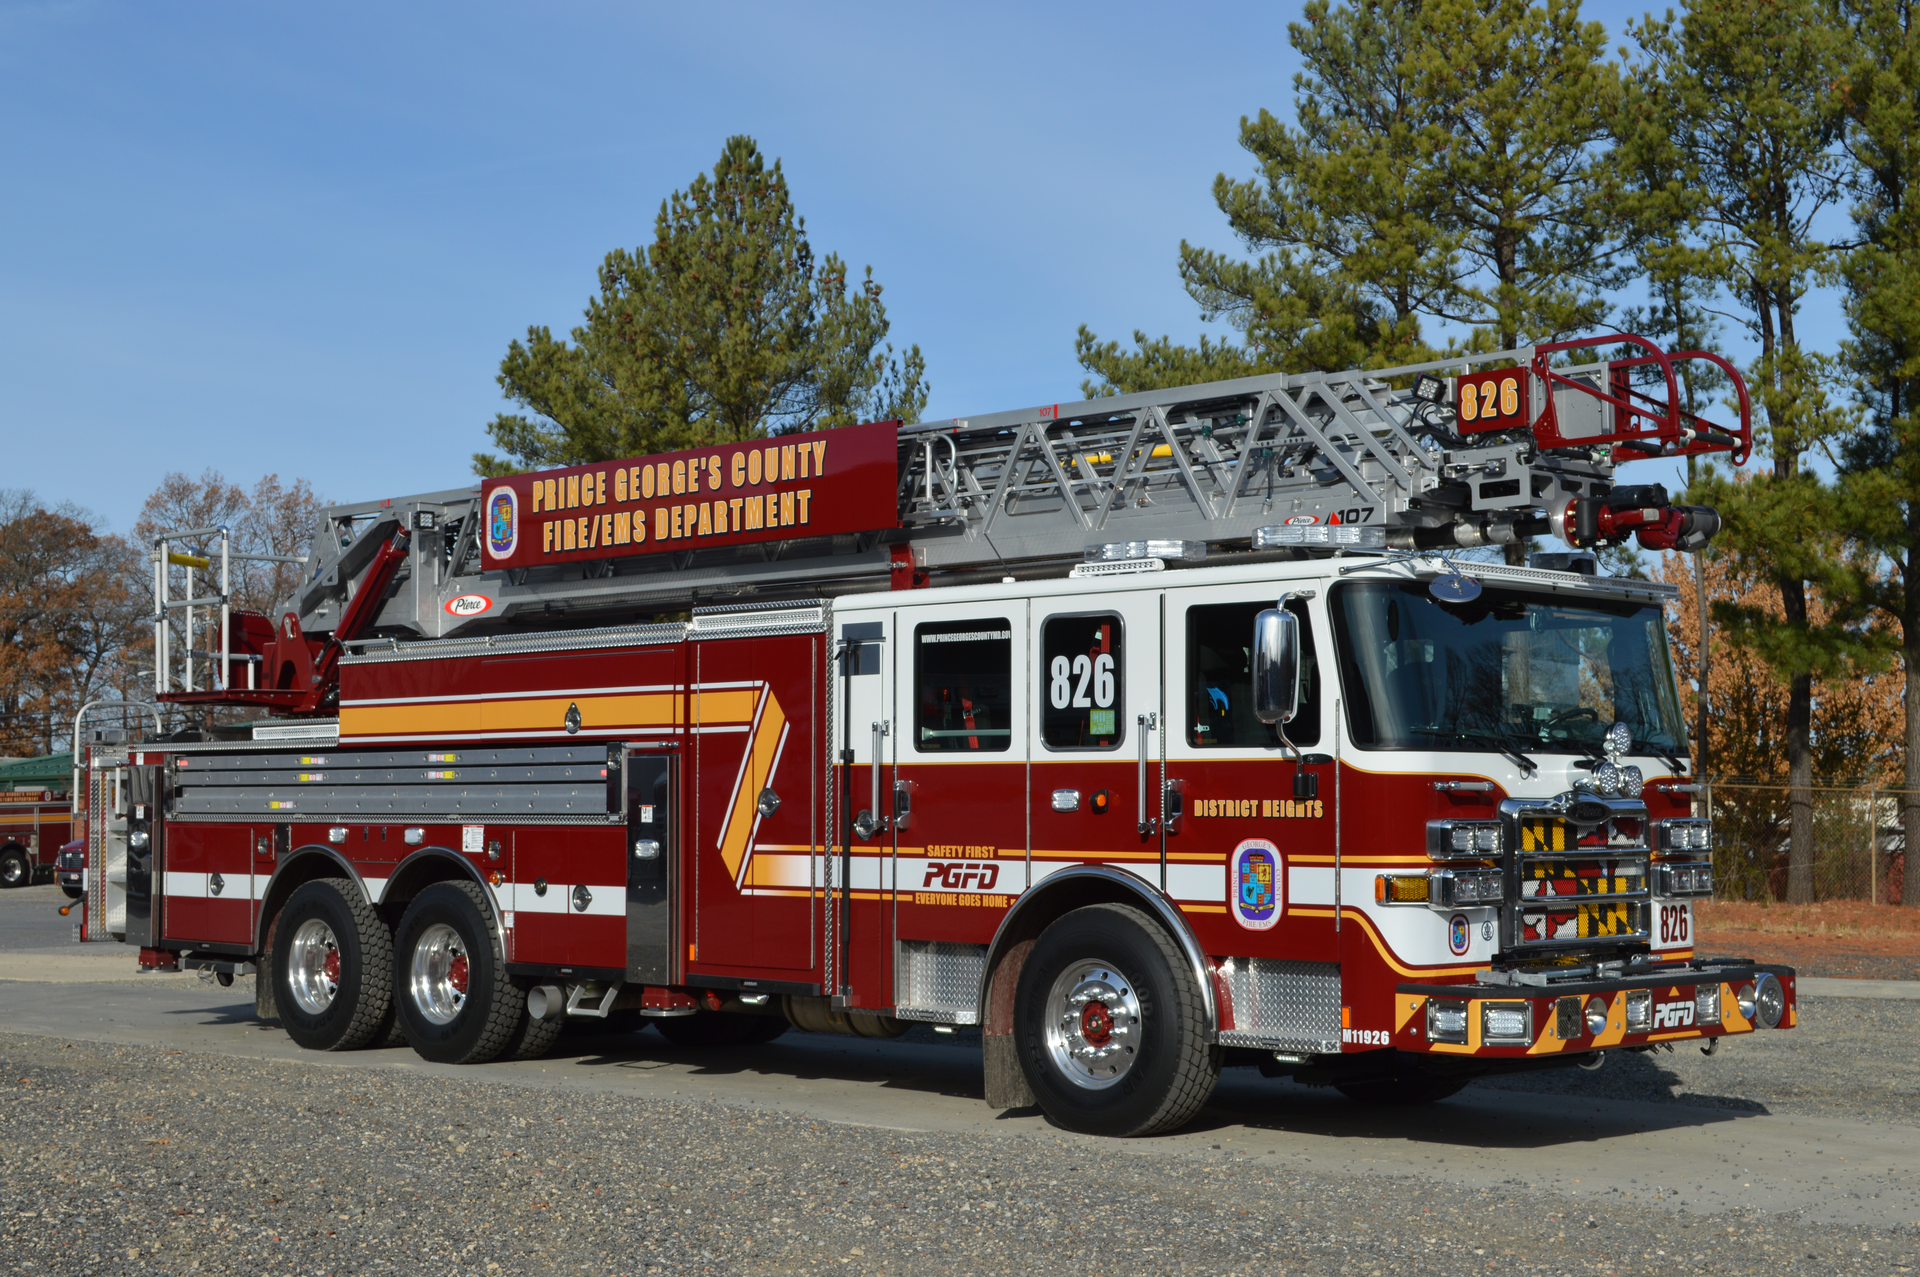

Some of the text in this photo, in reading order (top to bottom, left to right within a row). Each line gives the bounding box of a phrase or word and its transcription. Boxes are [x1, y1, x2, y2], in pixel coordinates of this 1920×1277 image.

[1461, 377, 1518, 421] 826
[1039, 407, 1051, 417] 107
[532, 440, 827, 513] PRINCE GEORGE'S COUNTY
[543, 489, 811, 553] FIRE/EMS DEPARTMENT
[455, 598, 482, 613] Pierce
[1050, 653, 1115, 710] 826
[1194, 799, 1323, 818] DISTRICT HEIGHTS
[927, 844, 995, 859] SAFETY FIRST
[1242, 841, 1271, 850] GEORGE'S
[922, 861, 1000, 890] PGFD
[915, 892, 1008, 908] EVERYONE GOES HOME
[1660, 904, 1688, 943] 826
[1653, 1000, 1695, 1029] PGFD
[1342, 1028, 1390, 1046] M11926
